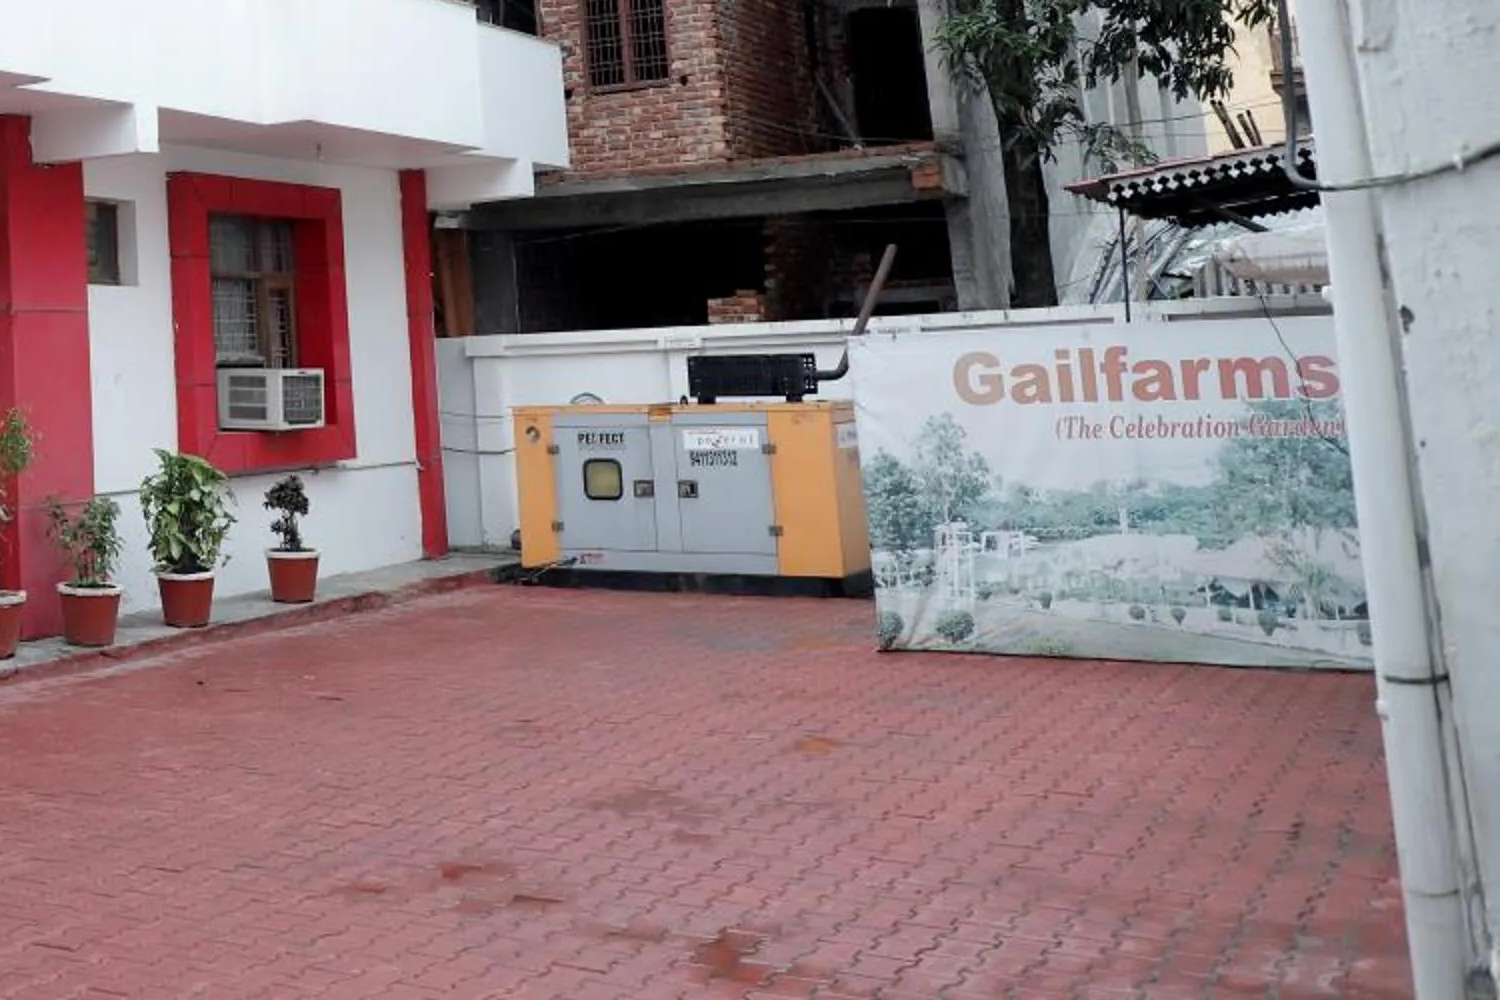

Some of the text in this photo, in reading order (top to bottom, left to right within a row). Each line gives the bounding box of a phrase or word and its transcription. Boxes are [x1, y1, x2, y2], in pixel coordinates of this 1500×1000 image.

[953, 345, 1341, 406] Gailfarms
[577, 432, 625, 445] PERFECT
[1055, 414, 1102, 441] (The
[1109, 413, 1240, 439] Celebration
